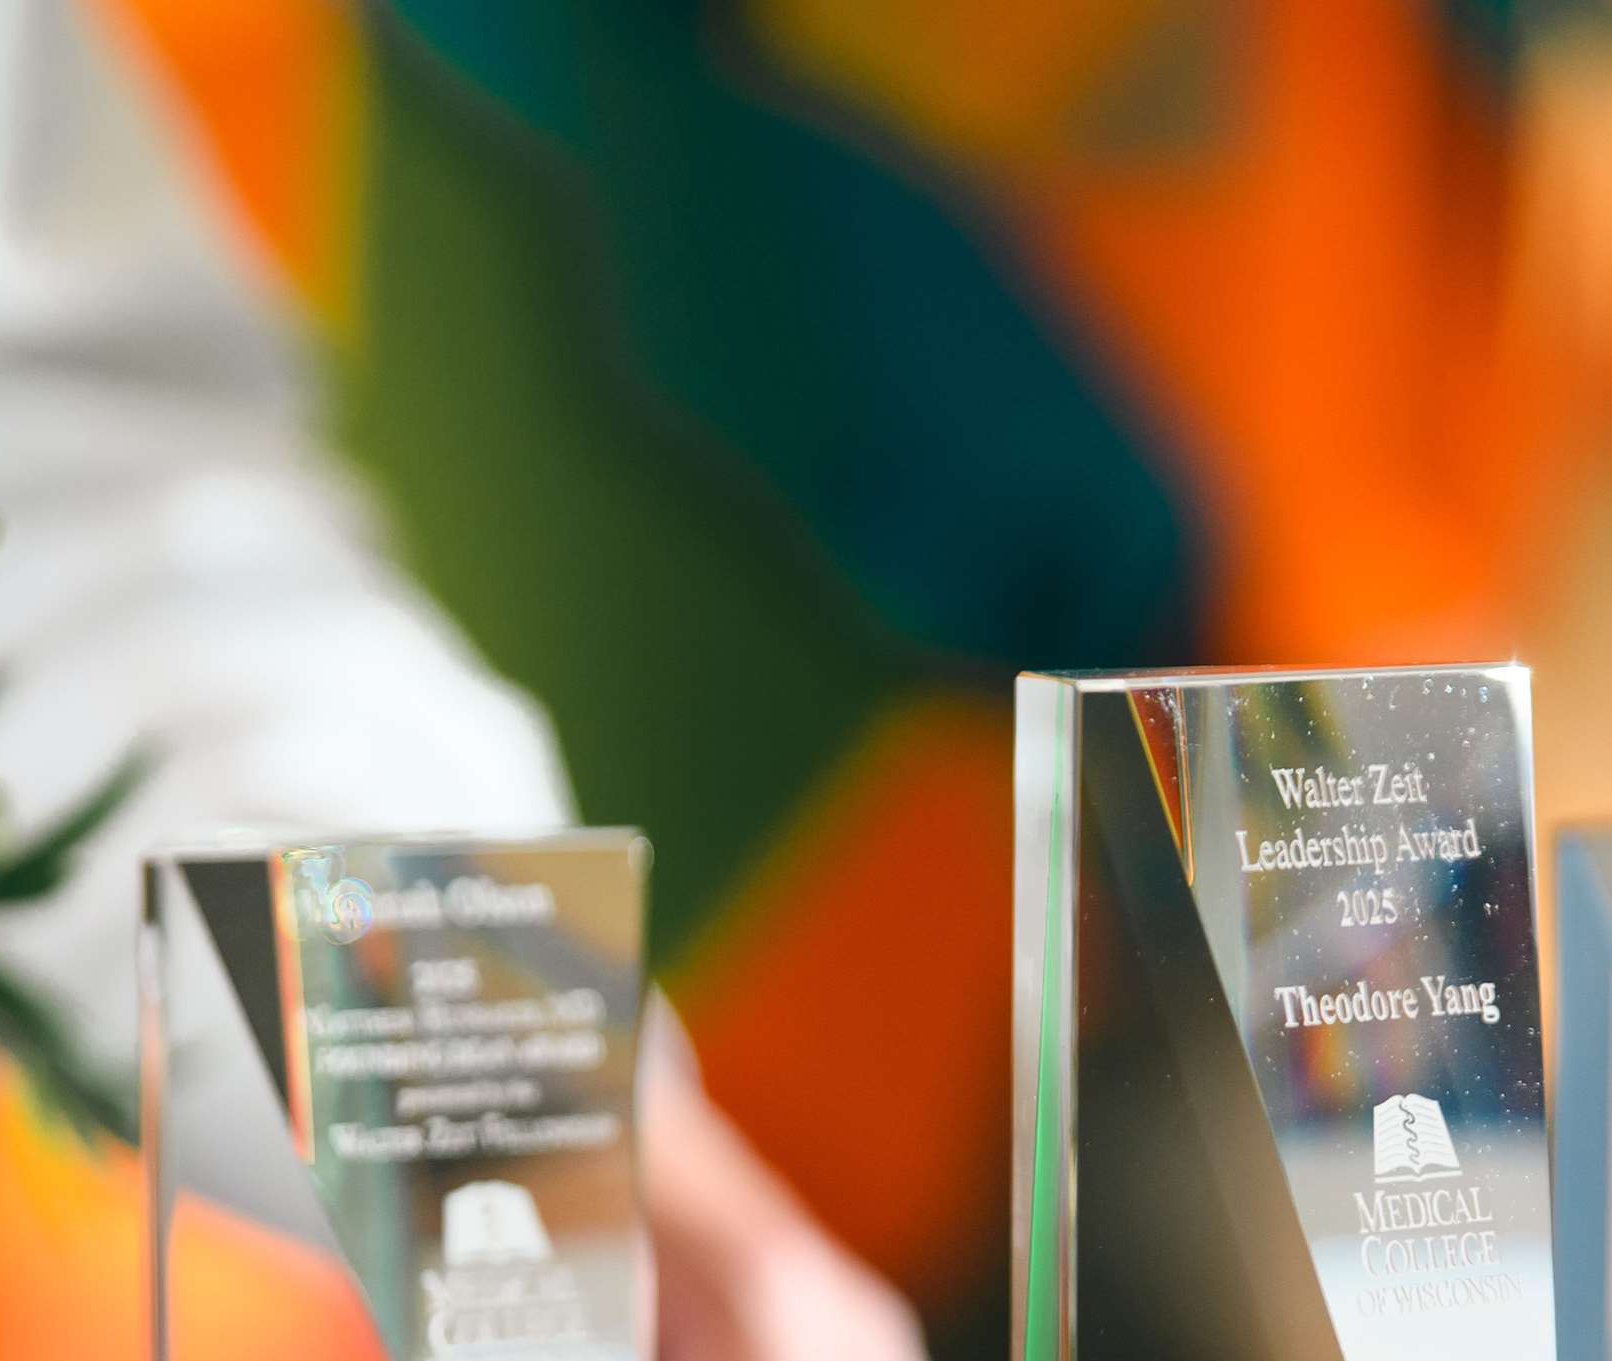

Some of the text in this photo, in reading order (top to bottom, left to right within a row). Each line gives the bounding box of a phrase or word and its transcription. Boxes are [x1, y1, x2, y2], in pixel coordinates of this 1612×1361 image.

[1270, 762, 1428, 809] Walter Zeit
[1235, 818, 1483, 875] Leadership Award
[1337, 887, 1399, 928] 2025
[1274, 974, 1501, 1028] Theodore Yang
[1353, 1187, 1494, 1234] MEDICAL
[1361, 1231, 1503, 1281] COLLEGE
[1391, 1272, 1525, 1315] WISCONSIN
